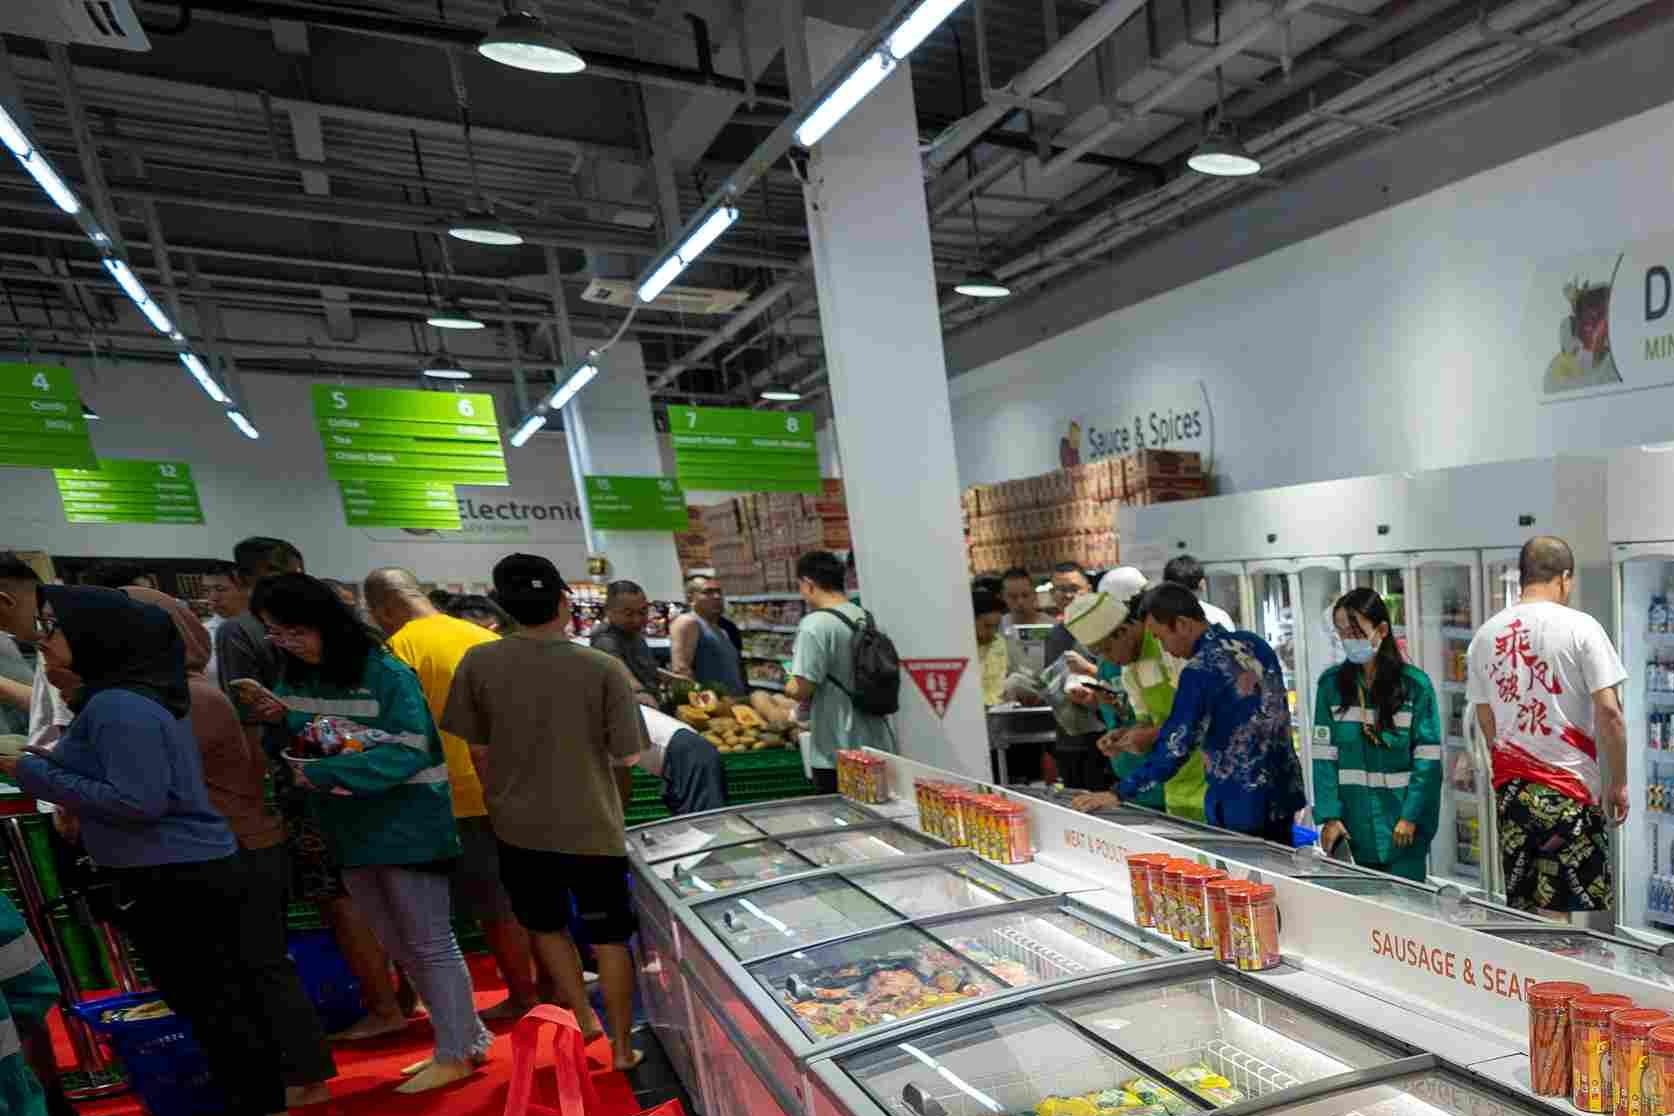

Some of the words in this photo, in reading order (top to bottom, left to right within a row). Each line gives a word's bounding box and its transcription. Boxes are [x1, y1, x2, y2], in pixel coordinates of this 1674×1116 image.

[32, 372, 49, 391] 4
[331, 391, 348, 410] 5
[457, 399, 475, 417] 6
[685, 411, 697, 429] 7
[786, 417, 800, 433] 8
[1088, 426, 1130, 458] Sauce
[1135, 416, 1145, 448] &
[1149, 408, 1203, 446] Spices
[1372, 929, 1457, 979] SAUSAGE
[1463, 957, 1476, 986] &
